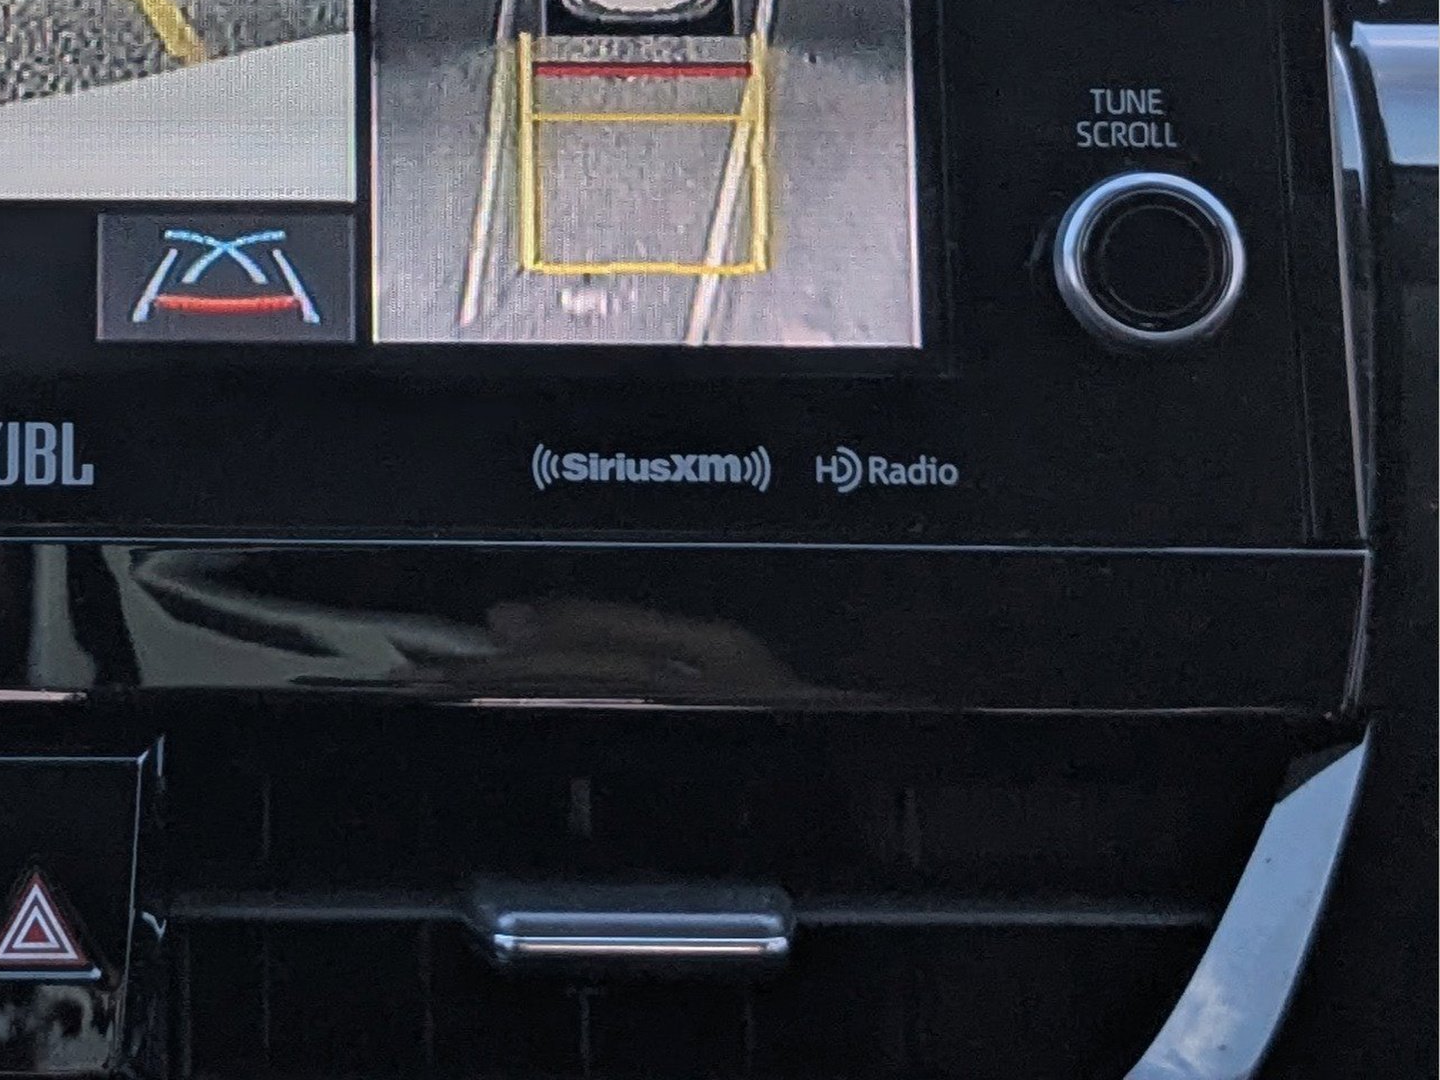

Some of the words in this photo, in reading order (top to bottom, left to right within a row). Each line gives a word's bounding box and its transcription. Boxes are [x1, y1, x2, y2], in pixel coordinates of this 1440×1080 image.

[1089, 88, 1165, 115] TUNE
[1076, 120, 1178, 149] SCROLL
[868, 454, 959, 486] Radio
